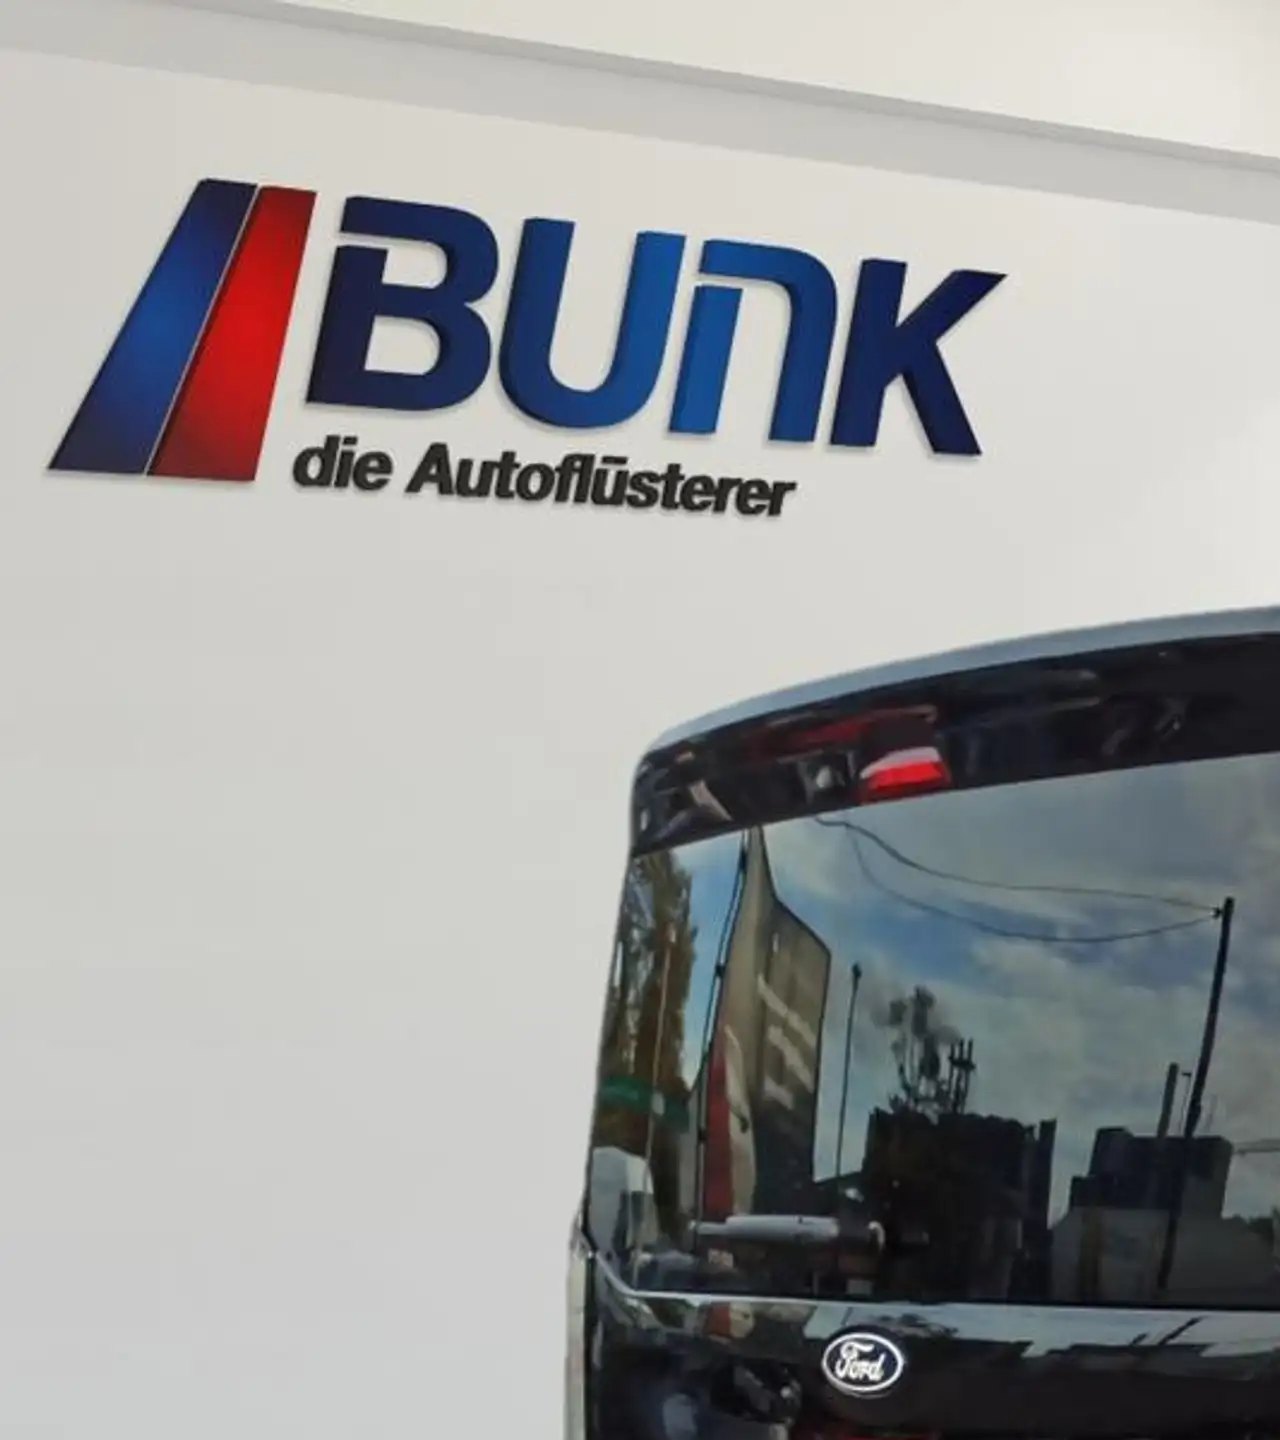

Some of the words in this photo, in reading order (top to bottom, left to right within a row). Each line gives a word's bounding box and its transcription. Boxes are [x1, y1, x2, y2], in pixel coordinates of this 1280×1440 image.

[307, 194, 1007, 457] BUNK
[292, 434, 394, 491] die
[404, 442, 798, 517] Autoflüsterer
[835, 1341, 887, 1381] Ford
